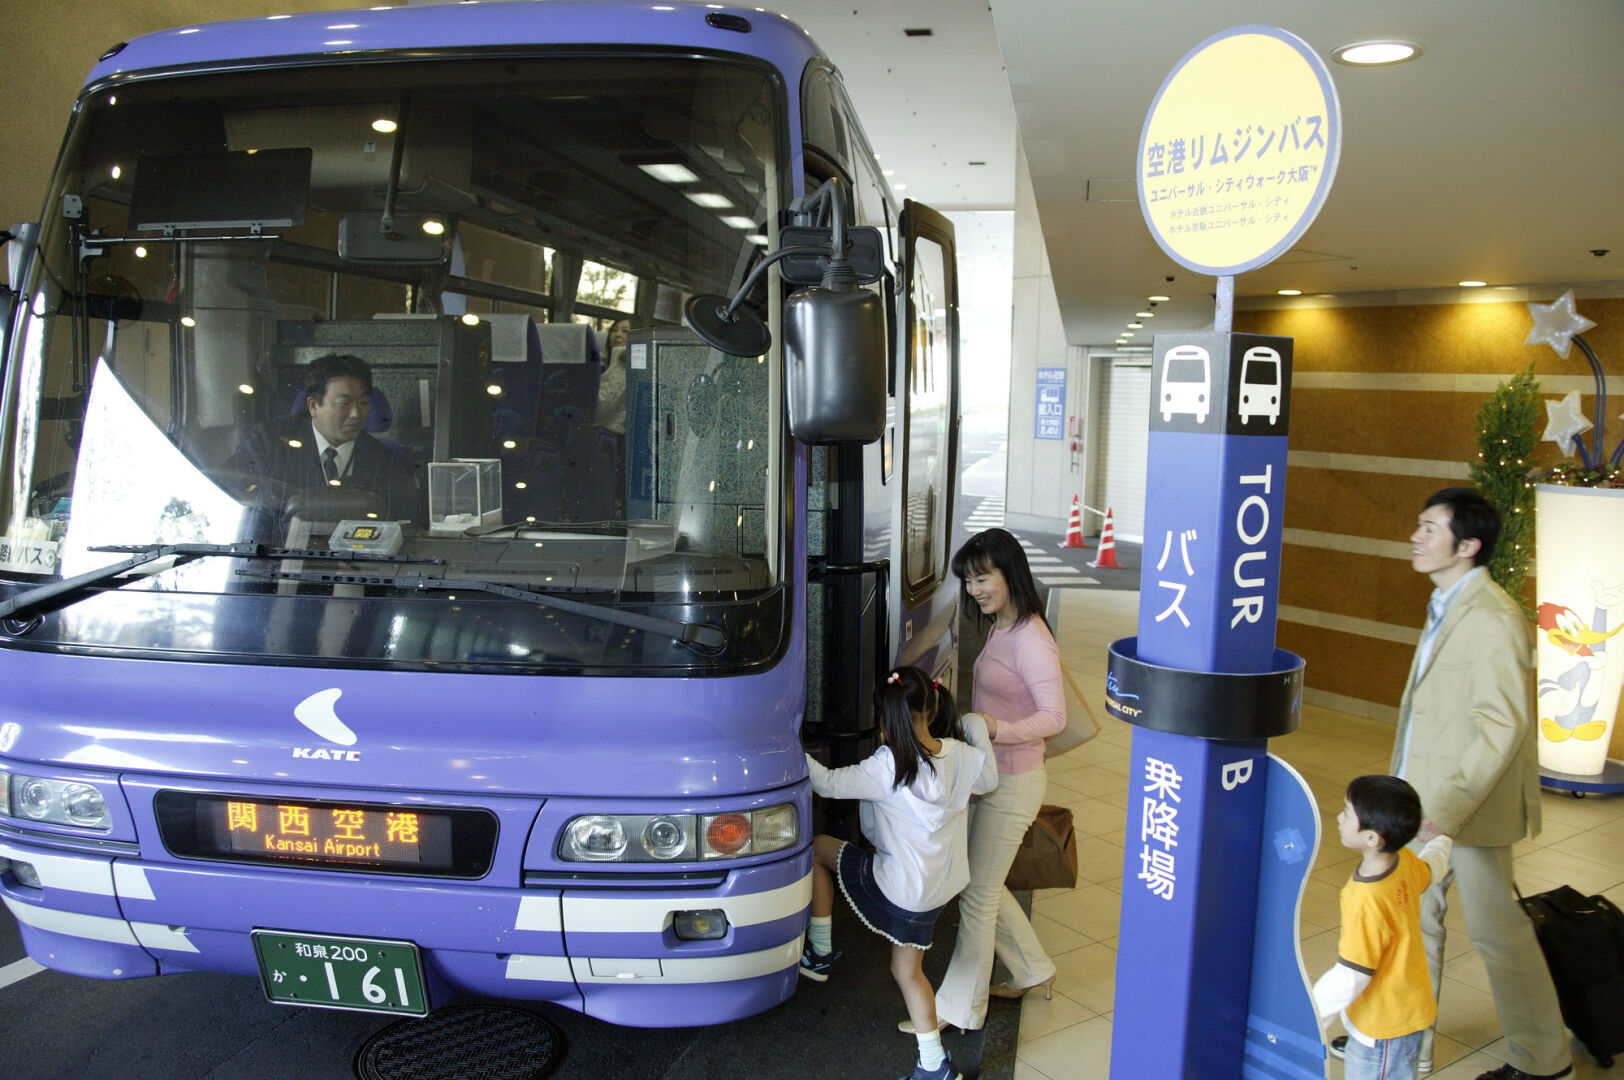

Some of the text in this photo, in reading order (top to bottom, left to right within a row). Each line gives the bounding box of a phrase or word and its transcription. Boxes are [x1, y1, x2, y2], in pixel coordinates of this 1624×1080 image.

[1147, 115, 1325, 178] 空港リムジンバス
[1231, 464, 1272, 629] TOUR
[1155, 529, 1197, 628] バス
[293, 747, 361, 762] KATE
[1221, 759, 1253, 791] B
[228, 801, 419, 843] 関西空港
[265, 834, 380, 857] Kansai Airport
[1138, 757, 1183, 900] 乗降場
